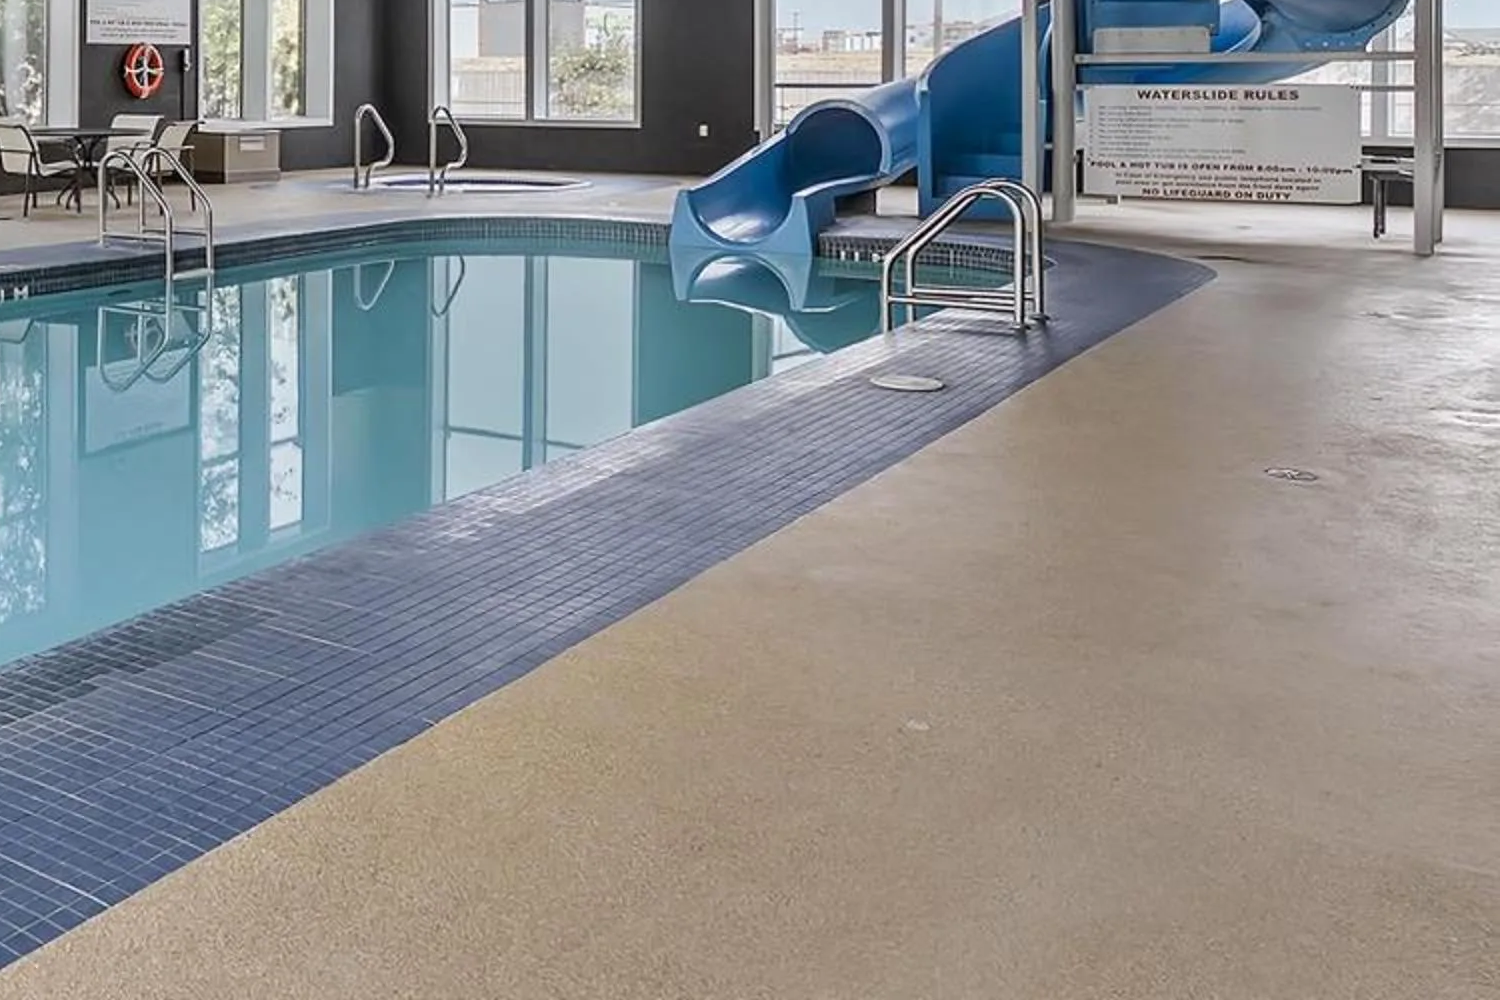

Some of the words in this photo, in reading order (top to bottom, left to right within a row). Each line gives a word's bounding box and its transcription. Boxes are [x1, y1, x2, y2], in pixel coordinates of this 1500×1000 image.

[1137, 89, 1238, 101] WATERSLIDE
[1243, 89, 1300, 101] RULES
[1090, 161, 1116, 169] POOL
[1130, 162, 1151, 170] HOT
[1155, 162, 1175, 170] TUB
[1191, 163, 1221, 171] OPEN
[1141, 187, 1160, 195] NO
[1163, 188, 1231, 199] LIFEGUARD
[1234, 191, 1253, 199] ON
[1256, 192, 1292, 200] DUTY
